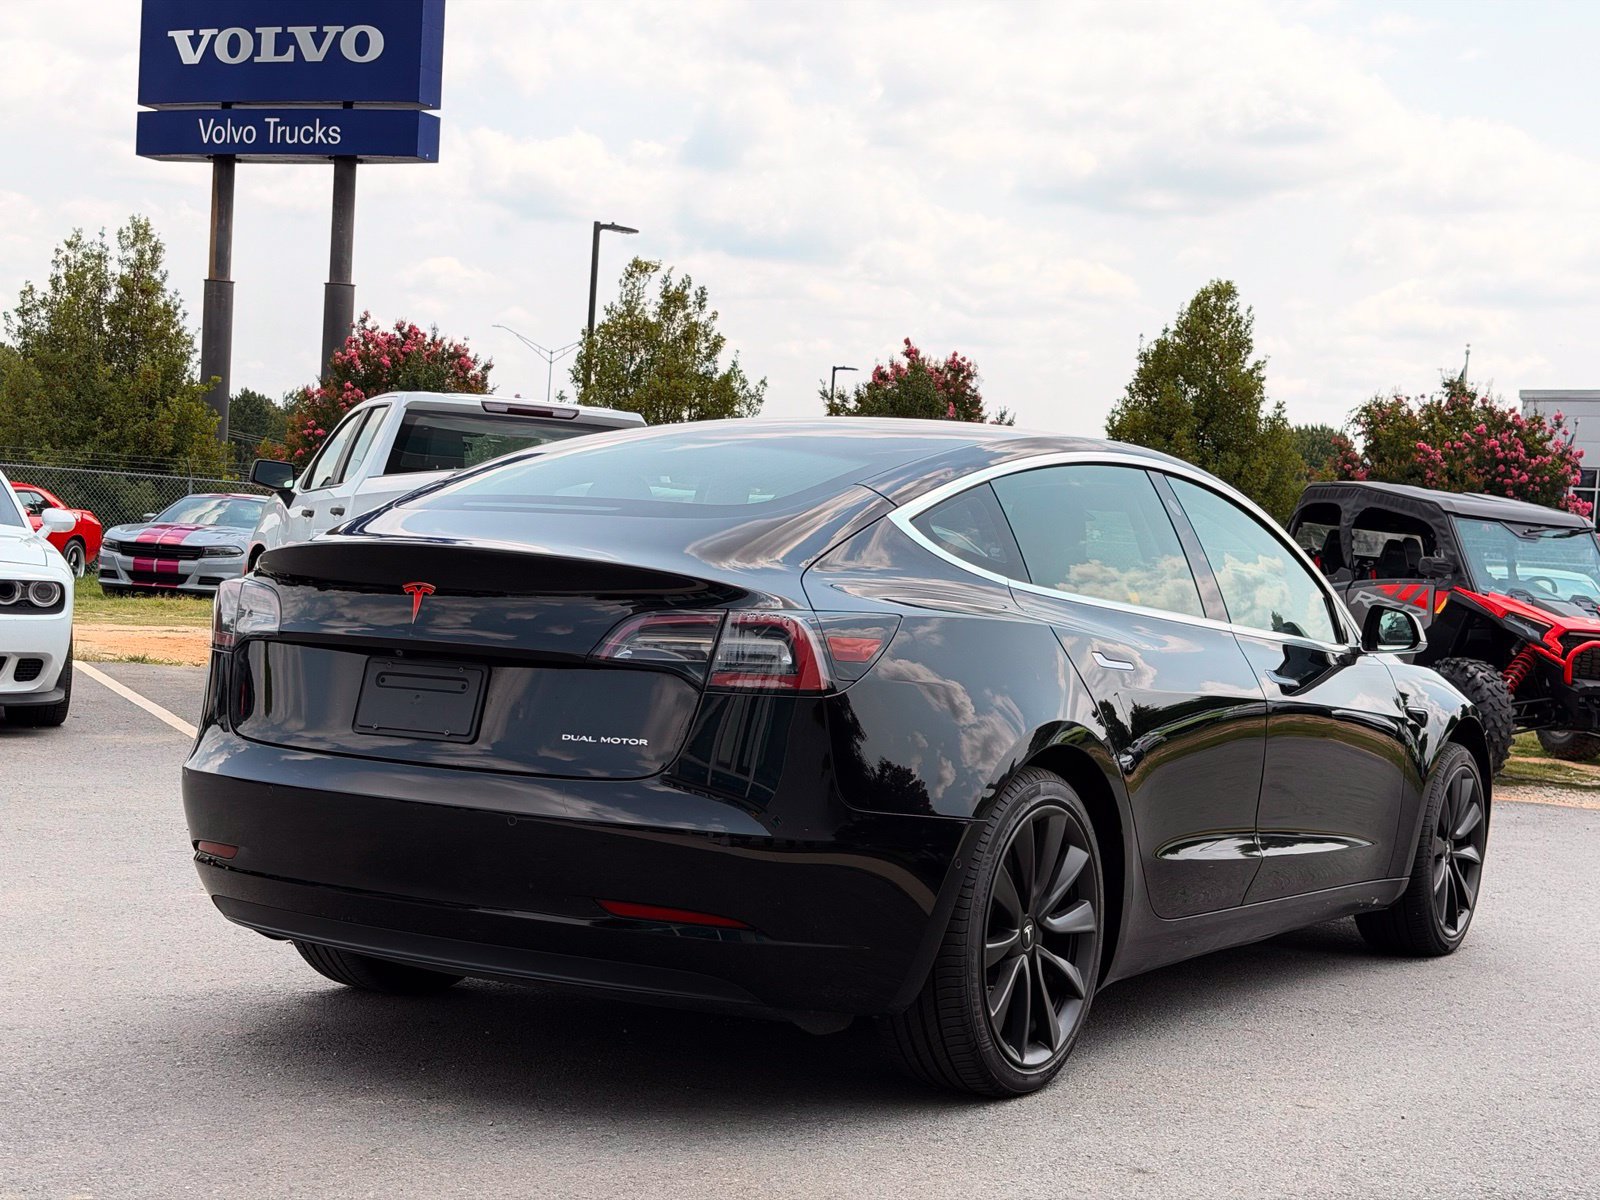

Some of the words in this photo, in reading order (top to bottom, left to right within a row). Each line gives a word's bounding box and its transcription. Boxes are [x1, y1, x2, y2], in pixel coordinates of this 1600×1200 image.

[167, 24, 385, 65] VOLVO
[198, 117, 257, 145] Volvo
[264, 117, 342, 145] Trucks
[562, 734, 597, 742] DUAL
[600, 736, 648, 745] MOTOR
